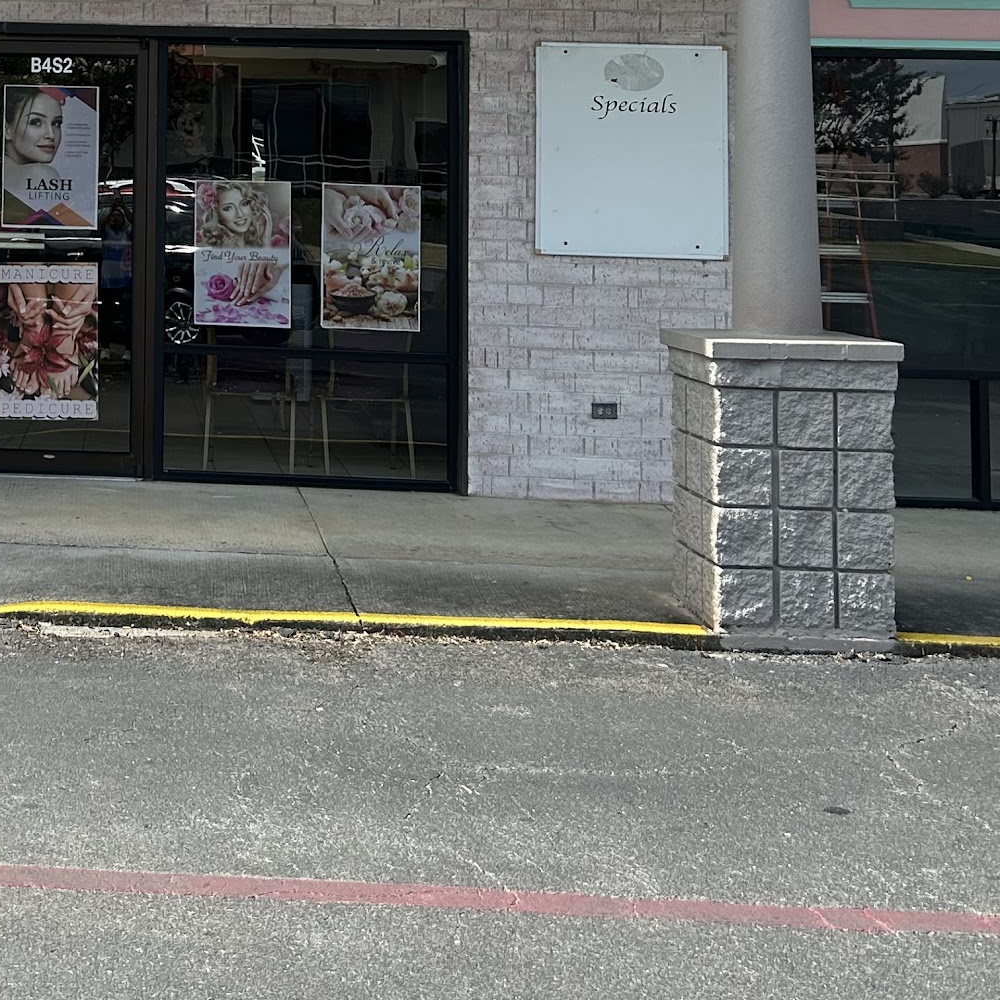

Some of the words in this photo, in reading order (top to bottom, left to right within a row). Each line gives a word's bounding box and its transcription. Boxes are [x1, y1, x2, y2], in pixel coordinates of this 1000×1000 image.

[30, 56, 73, 74] B4S2
[590, 93, 678, 119] Specials
[26, 178, 73, 191] LASH
[28, 191, 71, 201] LIFTING
[361, 233, 411, 258] Relax
[201, 250, 223, 262] Find
[223, 250, 247, 263] Your
[248, 251, 279, 265] Beauty
[0, 268, 95, 280] MANICURE
[1, 402, 95, 415] PEDICURE
